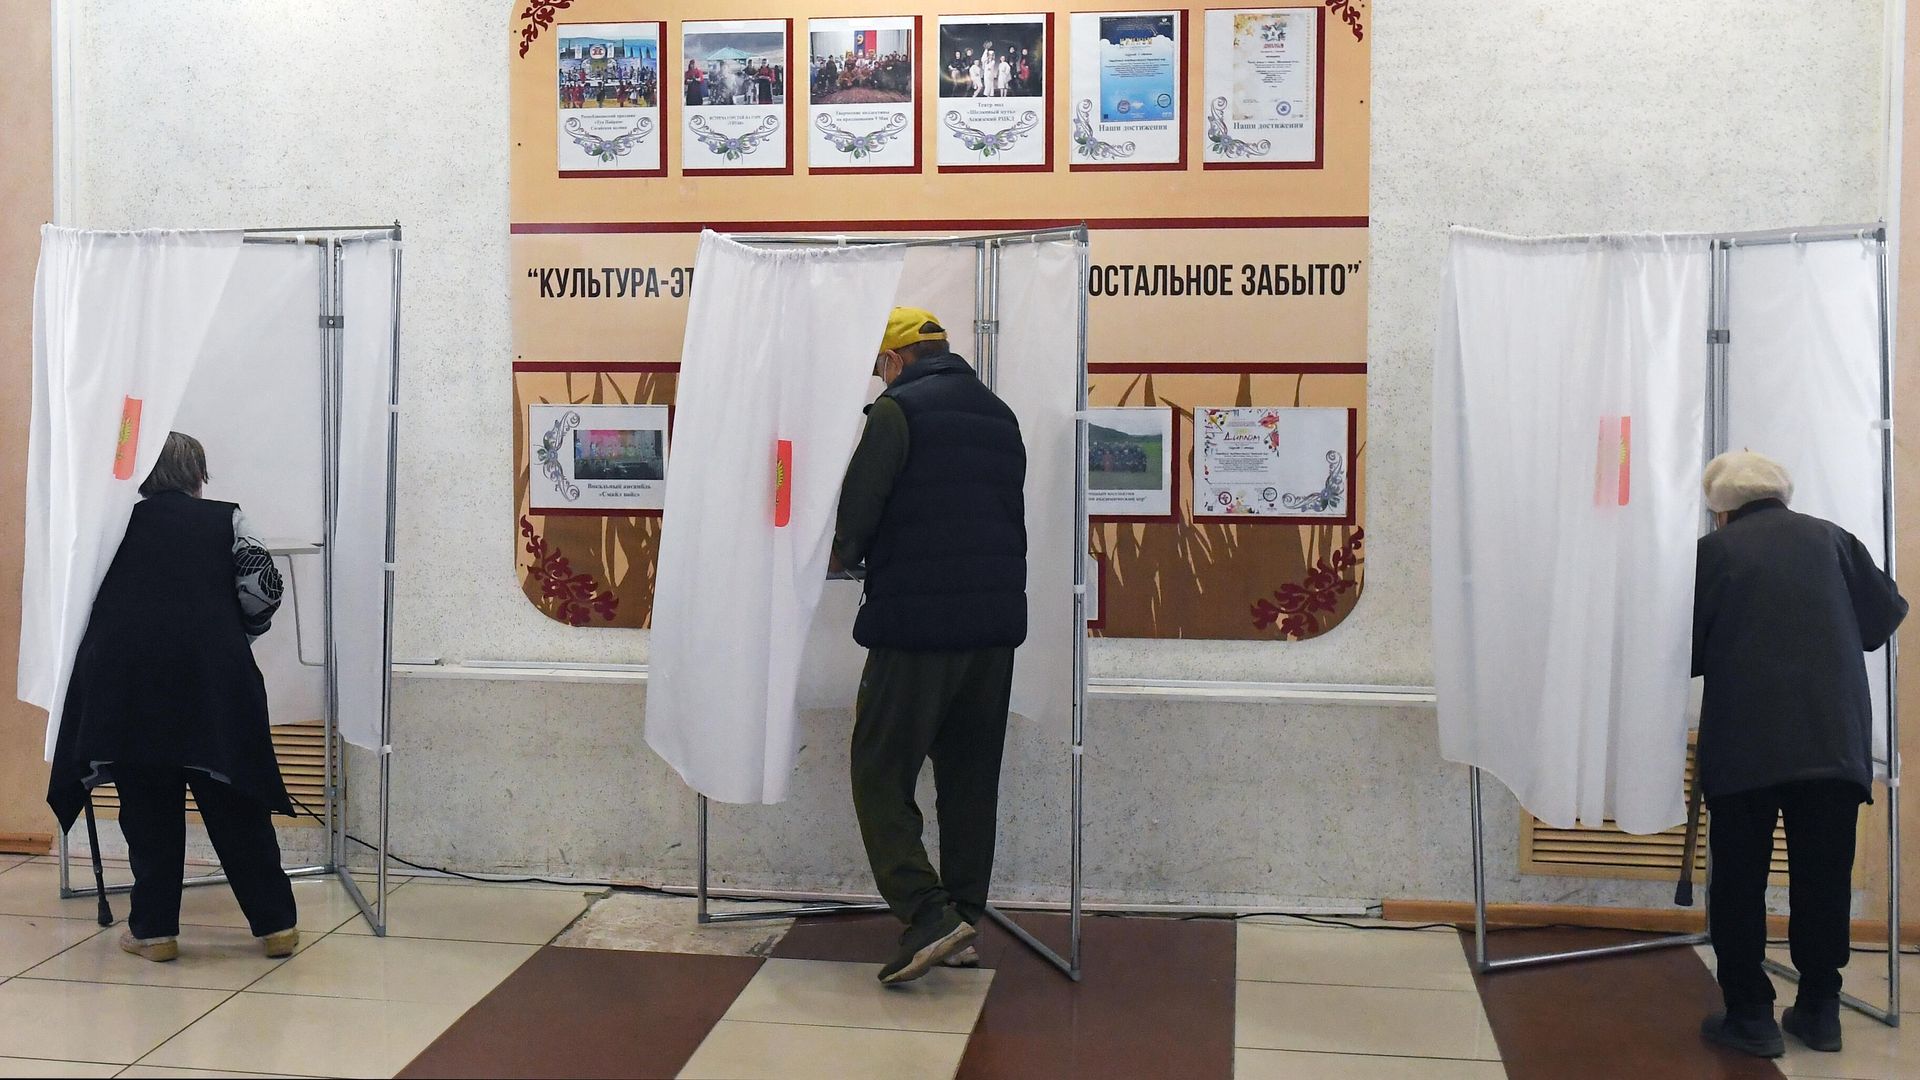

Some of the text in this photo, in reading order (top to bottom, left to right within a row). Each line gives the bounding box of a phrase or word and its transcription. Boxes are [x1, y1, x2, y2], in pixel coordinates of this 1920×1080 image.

[1099, 124, 1168, 132] Наши достижения
[1233, 122, 1304, 130] Наши достижения
[1088, 263, 1360, 296] ОСТАЛЬНОЕ ЗАБЫТО”
